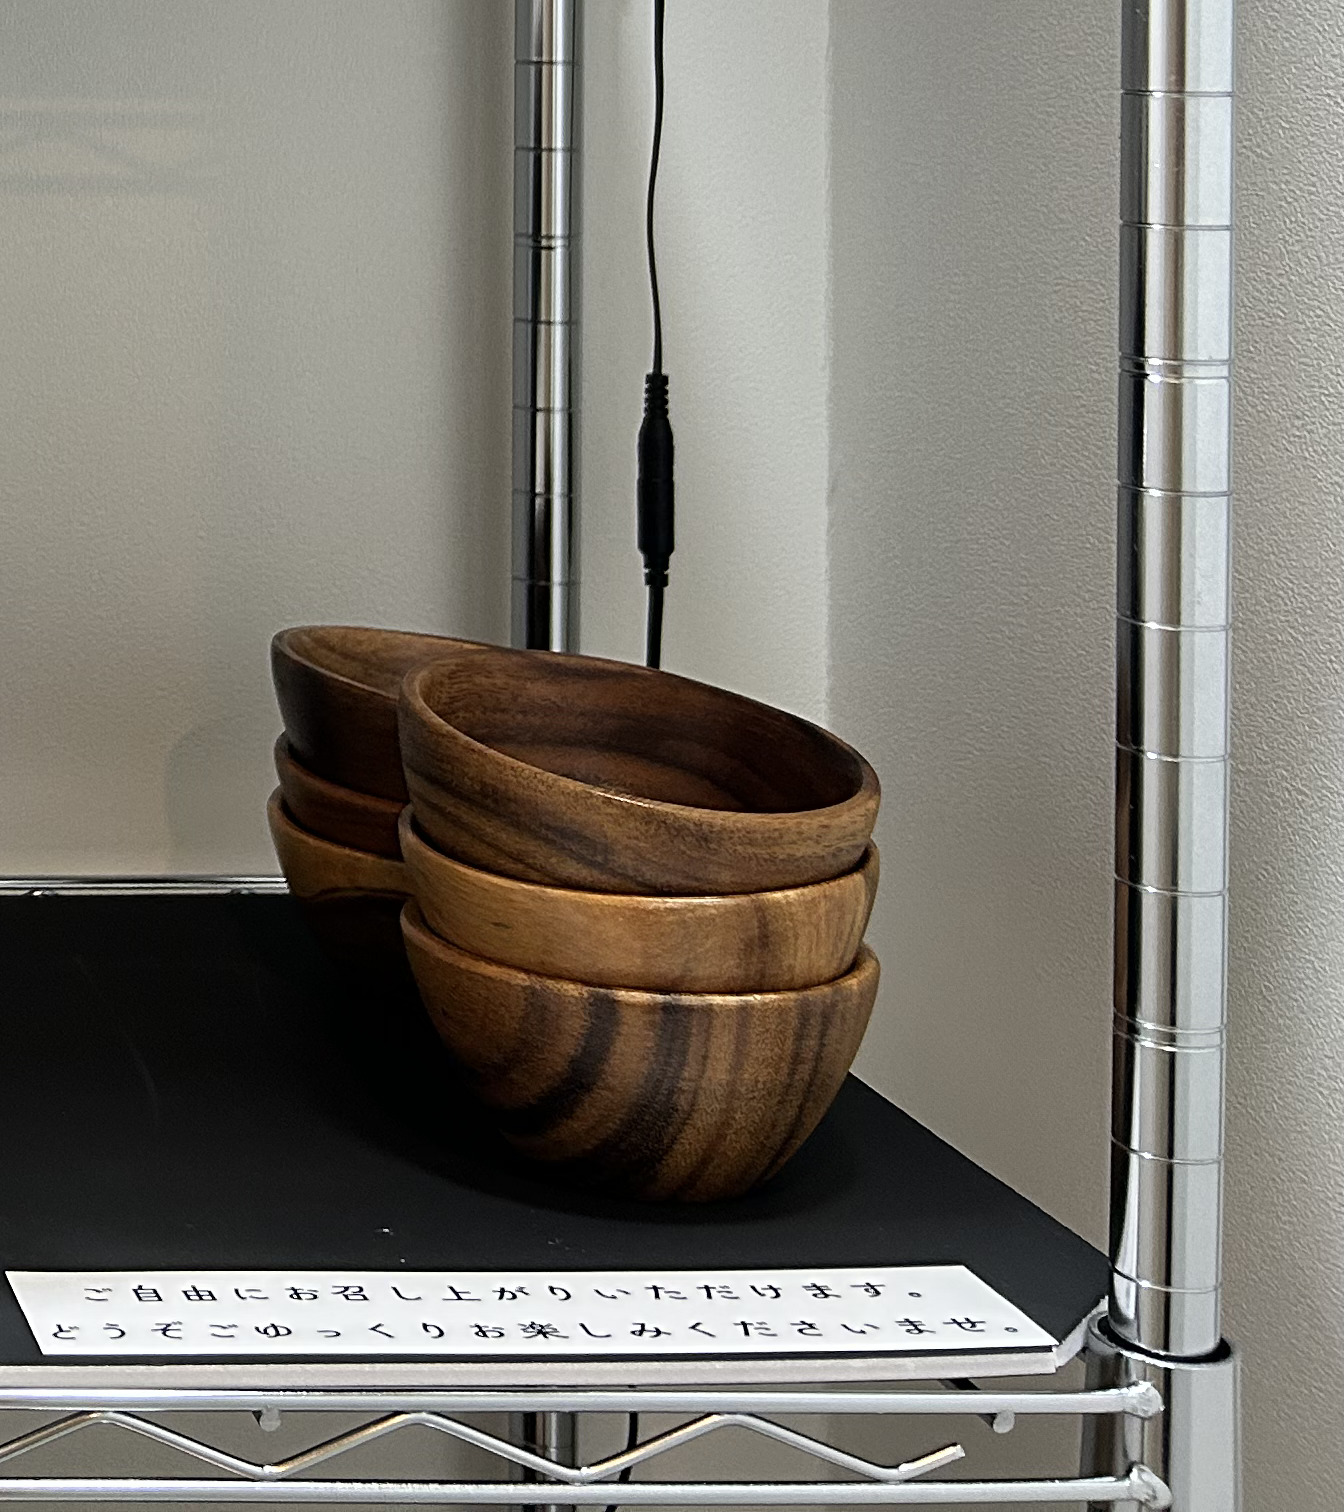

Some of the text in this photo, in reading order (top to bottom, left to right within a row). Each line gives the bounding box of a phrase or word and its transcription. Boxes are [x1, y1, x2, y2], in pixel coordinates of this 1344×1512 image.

[84, 1281, 921, 1303] ご自由にお召し上がりいただけます。
[52, 1318, 1018, 1340] どうぞごゆっくりお楽しみくださいませ。
